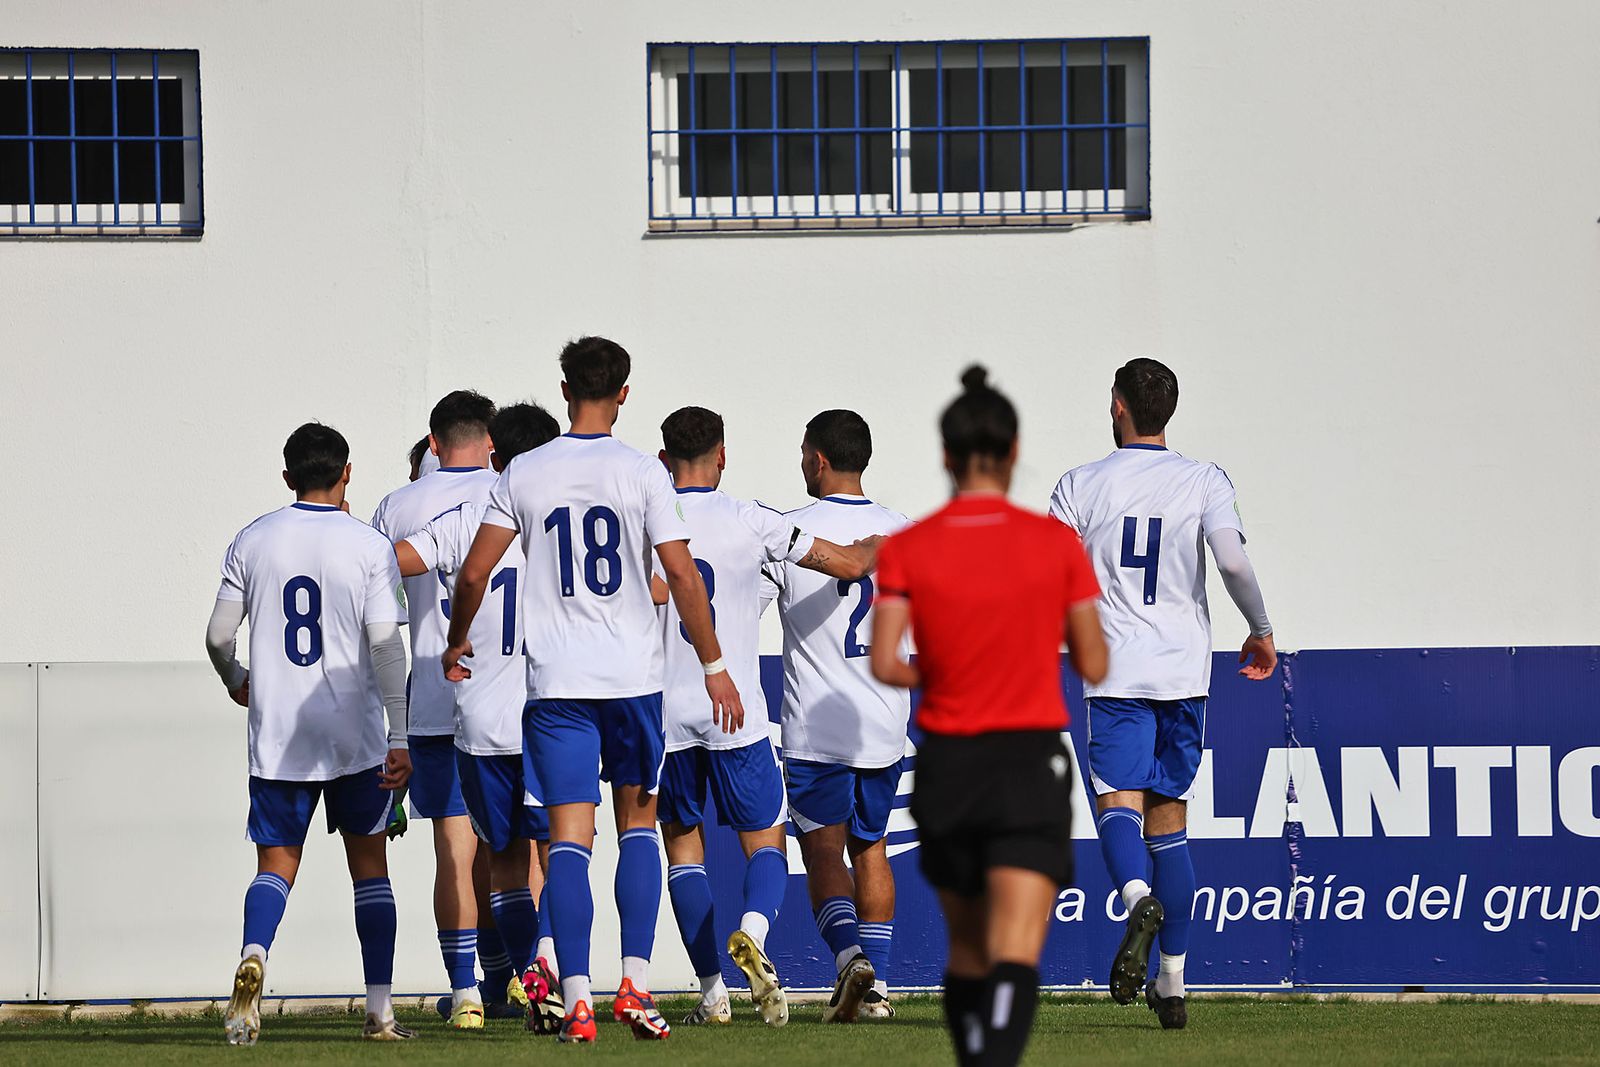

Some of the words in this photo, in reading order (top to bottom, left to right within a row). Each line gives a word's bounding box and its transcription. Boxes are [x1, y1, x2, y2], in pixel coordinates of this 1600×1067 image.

[543, 505, 622, 598] 18
[1120, 516, 1162, 605] 4
[282, 574, 323, 667] 8
[490, 566, 527, 656] 1
[836, 574, 875, 659] 2
[1060, 731, 1600, 840] LANTI
[1385, 874, 1468, 921] del
